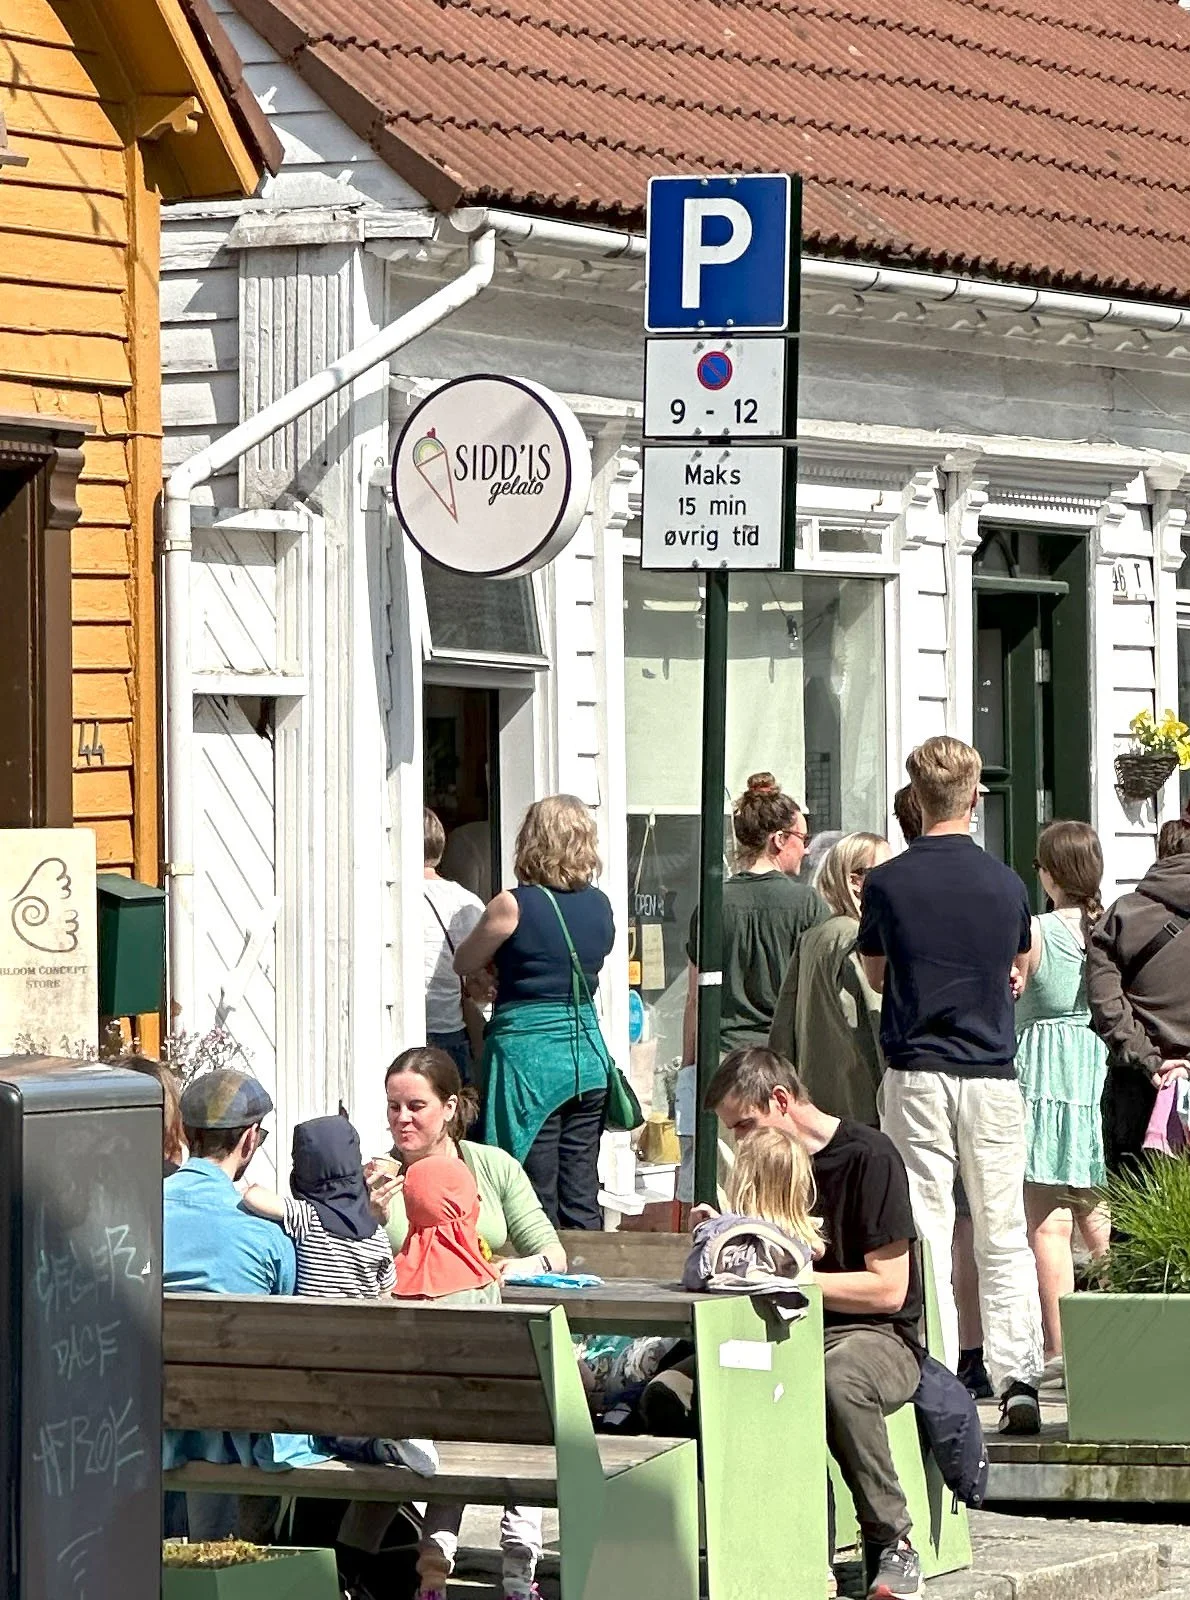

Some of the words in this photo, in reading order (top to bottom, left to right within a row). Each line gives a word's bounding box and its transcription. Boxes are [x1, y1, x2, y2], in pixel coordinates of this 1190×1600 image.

[682, 198, 752, 308] P
[670, 398, 686, 425] 9
[734, 398, 758, 424] 12
[453, 443, 552, 482] SIDD'IS
[684, 464, 741, 485] Maks
[487, 474, 545, 506] gelato
[678, 496, 696, 515] 15
[709, 493, 746, 516] min
[664, 524, 719, 551] øvrig
[732, 524, 759, 546] tid
[1112, 563, 1127, 592] 46
[78, 721, 105, 766] 44
[25, 979, 61, 989] STORE
[38, 965, 88, 976] CONCEPT
